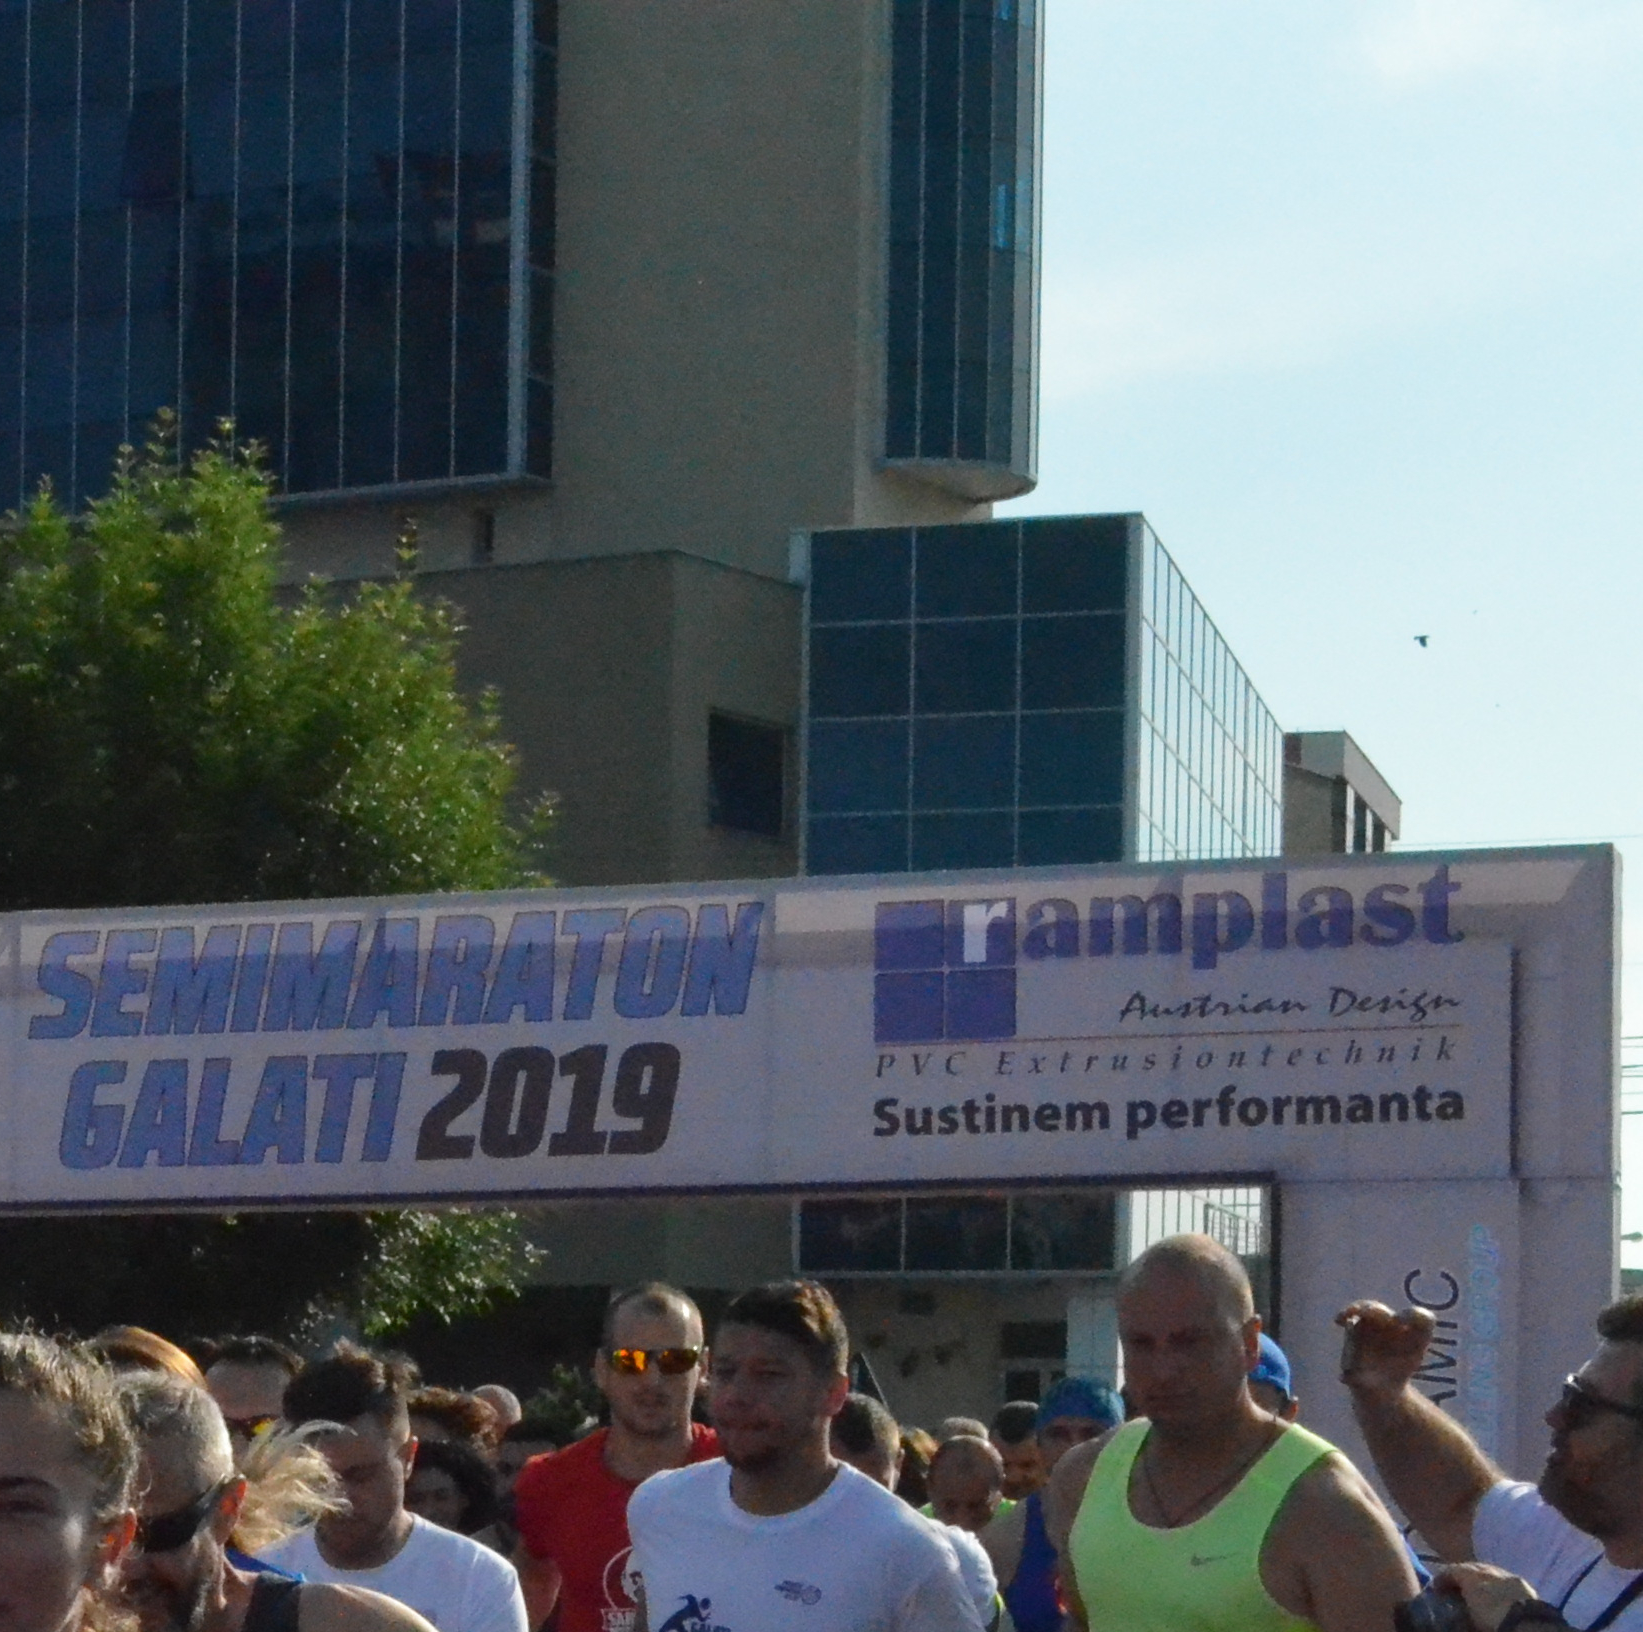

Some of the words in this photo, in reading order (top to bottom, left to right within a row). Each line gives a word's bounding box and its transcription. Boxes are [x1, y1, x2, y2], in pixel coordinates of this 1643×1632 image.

[961, 863, 1465, 970] ramplast
[27, 901, 765, 1041] SEMIMARATON
[1117, 990, 1310, 1023] Austrian
[1327, 986, 1462, 1023] Design
[875, 1050, 969, 1078] PVC
[995, 1039, 1458, 1076] Extrusiontechnik
[58, 1052, 408, 1171] GALATI
[415, 1042, 681, 1161] 2019
[873, 1092, 1111, 1138] Sustinem
[1124, 1084, 1467, 1141] performanta
